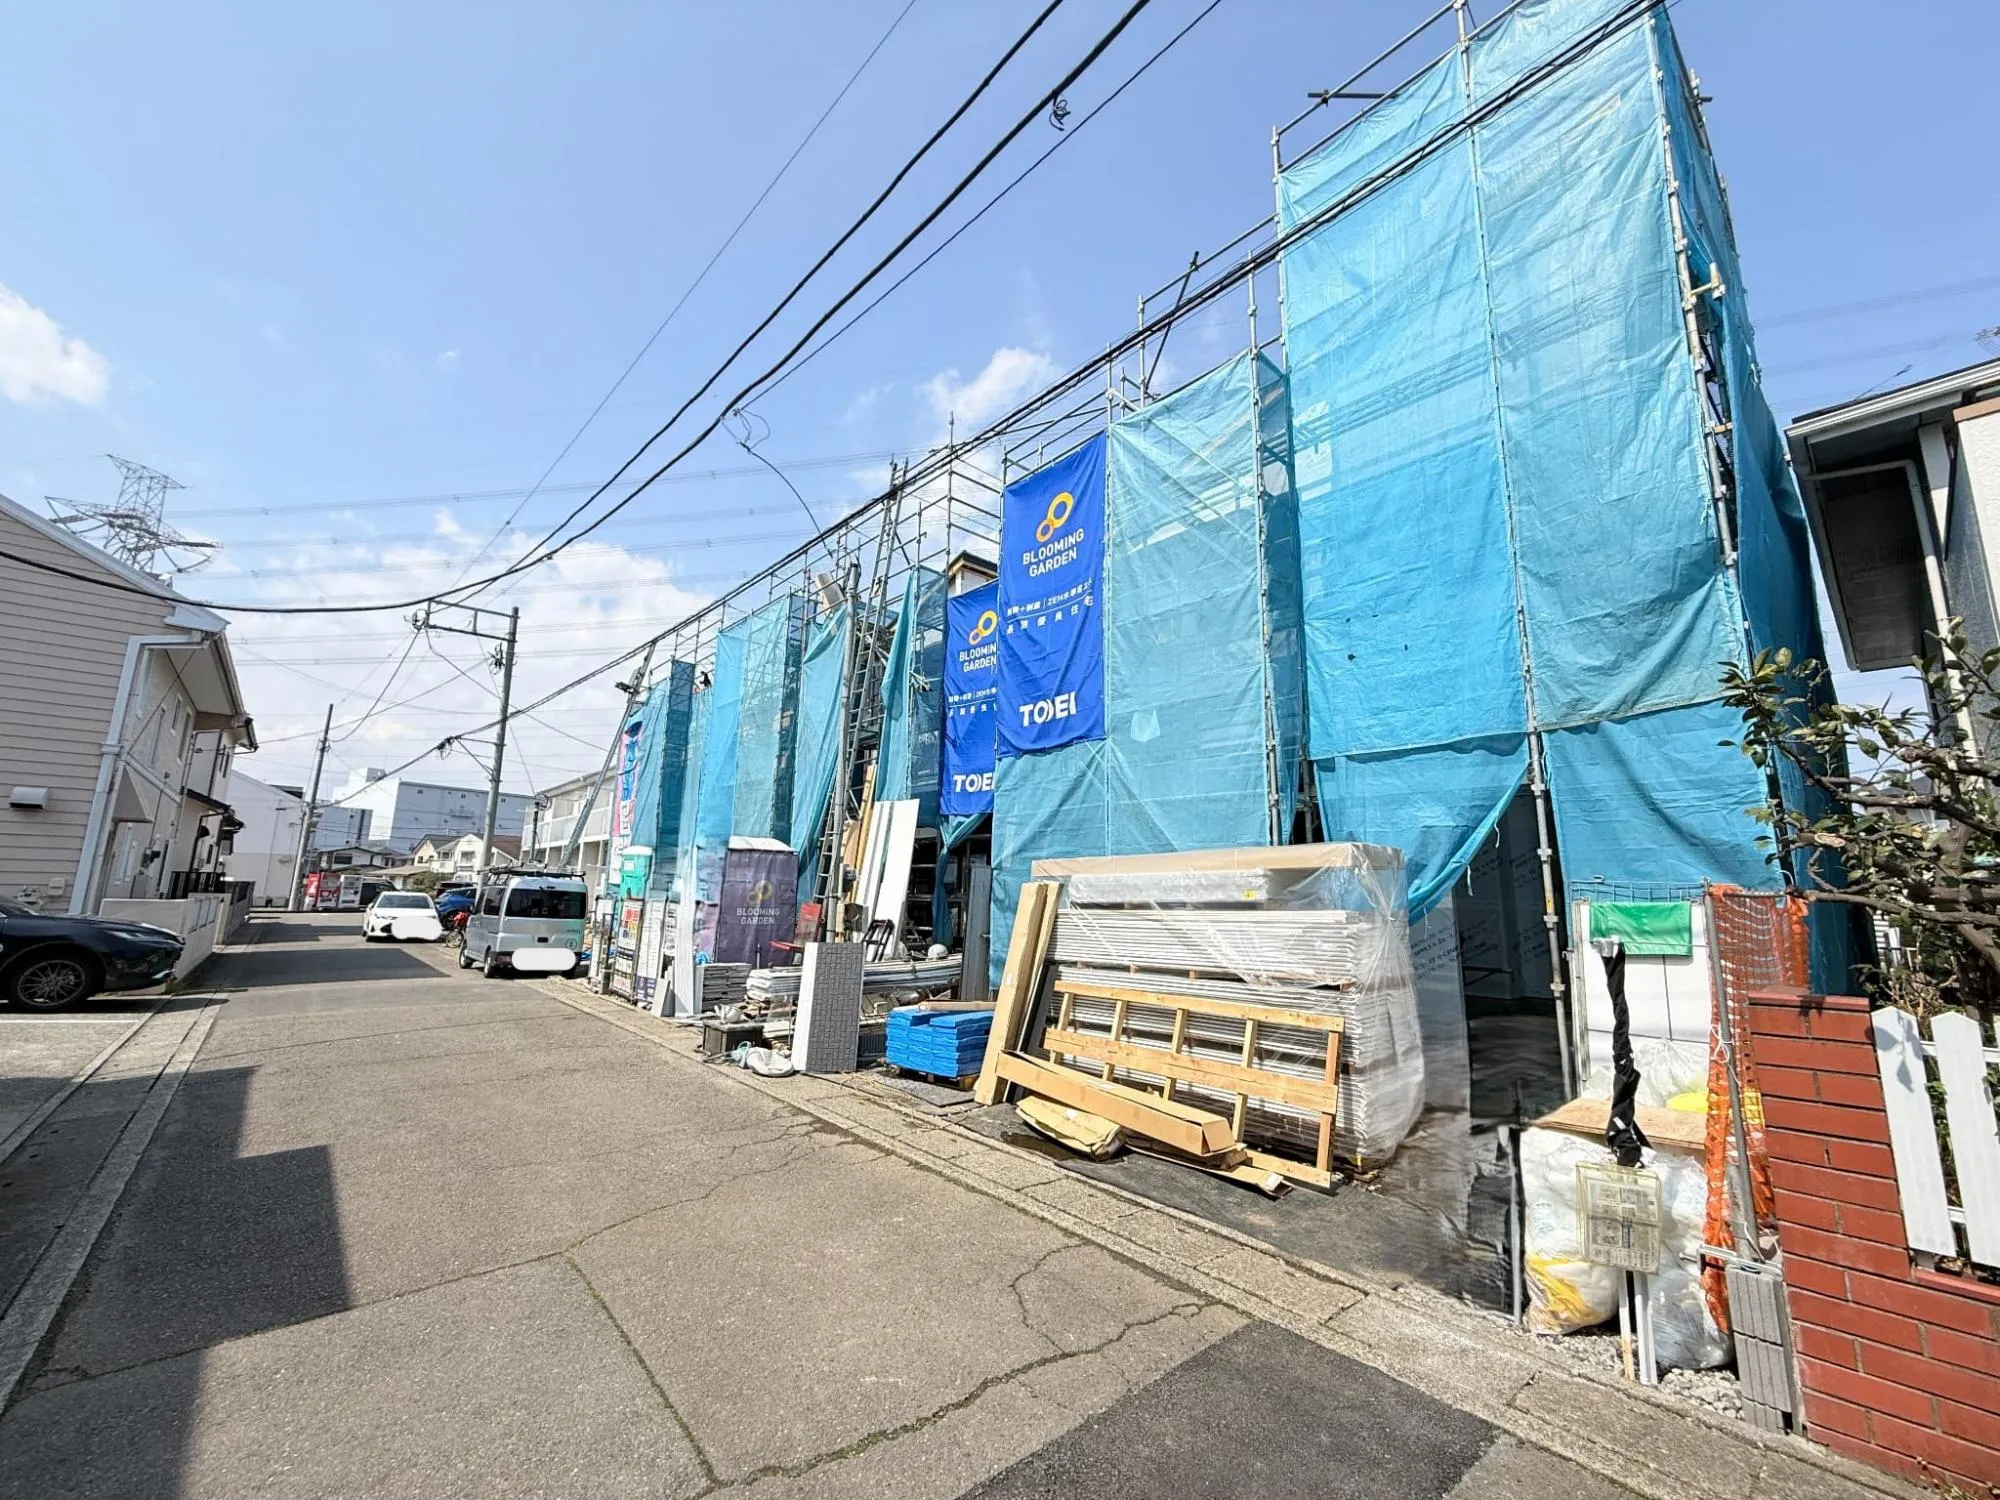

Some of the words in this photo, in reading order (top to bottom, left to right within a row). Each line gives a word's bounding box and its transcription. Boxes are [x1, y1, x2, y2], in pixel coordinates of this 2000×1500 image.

[1022, 528, 1084, 565] BLOOMING
[1029, 547, 1077, 577] GARDEN
[959, 643, 997, 662] BLOOMIN
[963, 655, 997, 673] GARDEN
[1018, 690, 1077, 727] TOEI
[736, 907, 781, 916] BLOOMING
[740, 916, 776, 925] GARDEN
